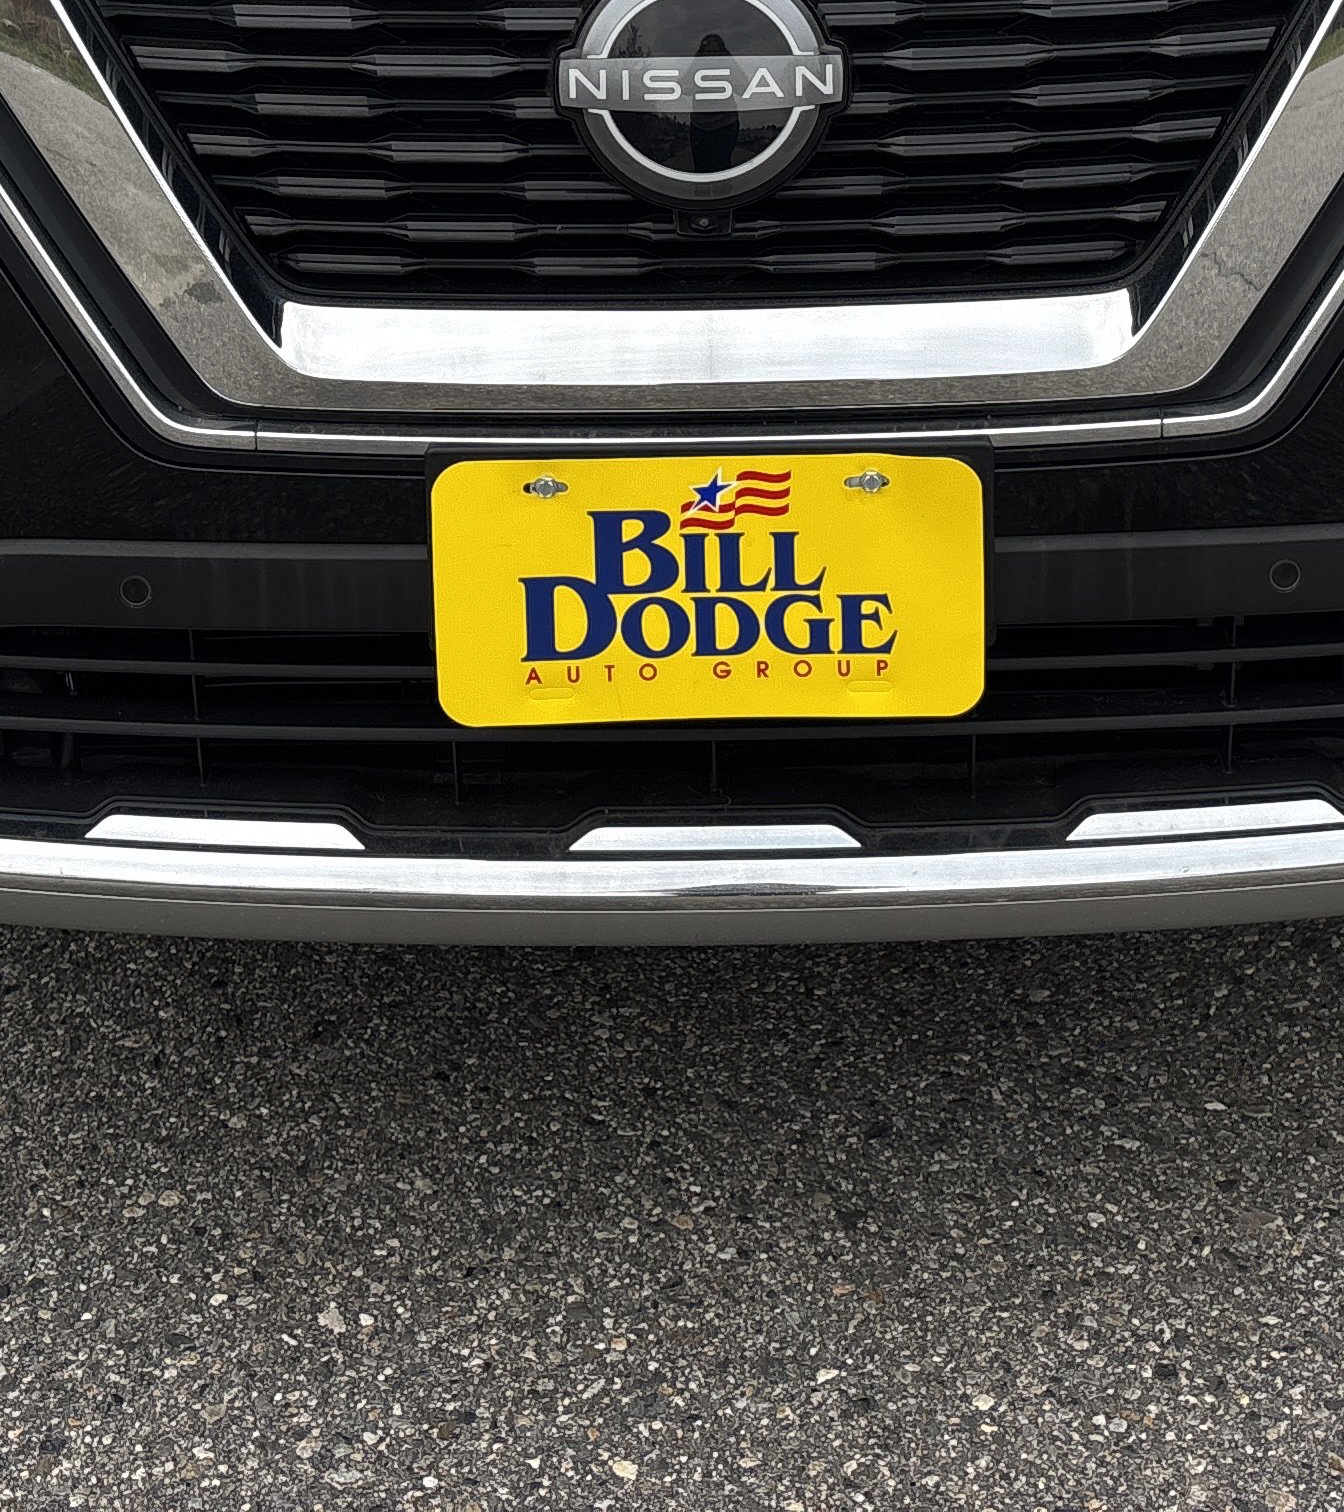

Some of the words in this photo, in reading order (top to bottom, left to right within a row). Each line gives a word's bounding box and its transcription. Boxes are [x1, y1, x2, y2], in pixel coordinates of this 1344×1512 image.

[568, 63, 835, 101] NISSAN
[587, 510, 827, 594] BILL
[518, 576, 899, 662] DODGE
[524, 663, 659, 685] AUTO
[711, 658, 890, 680] GROUP
